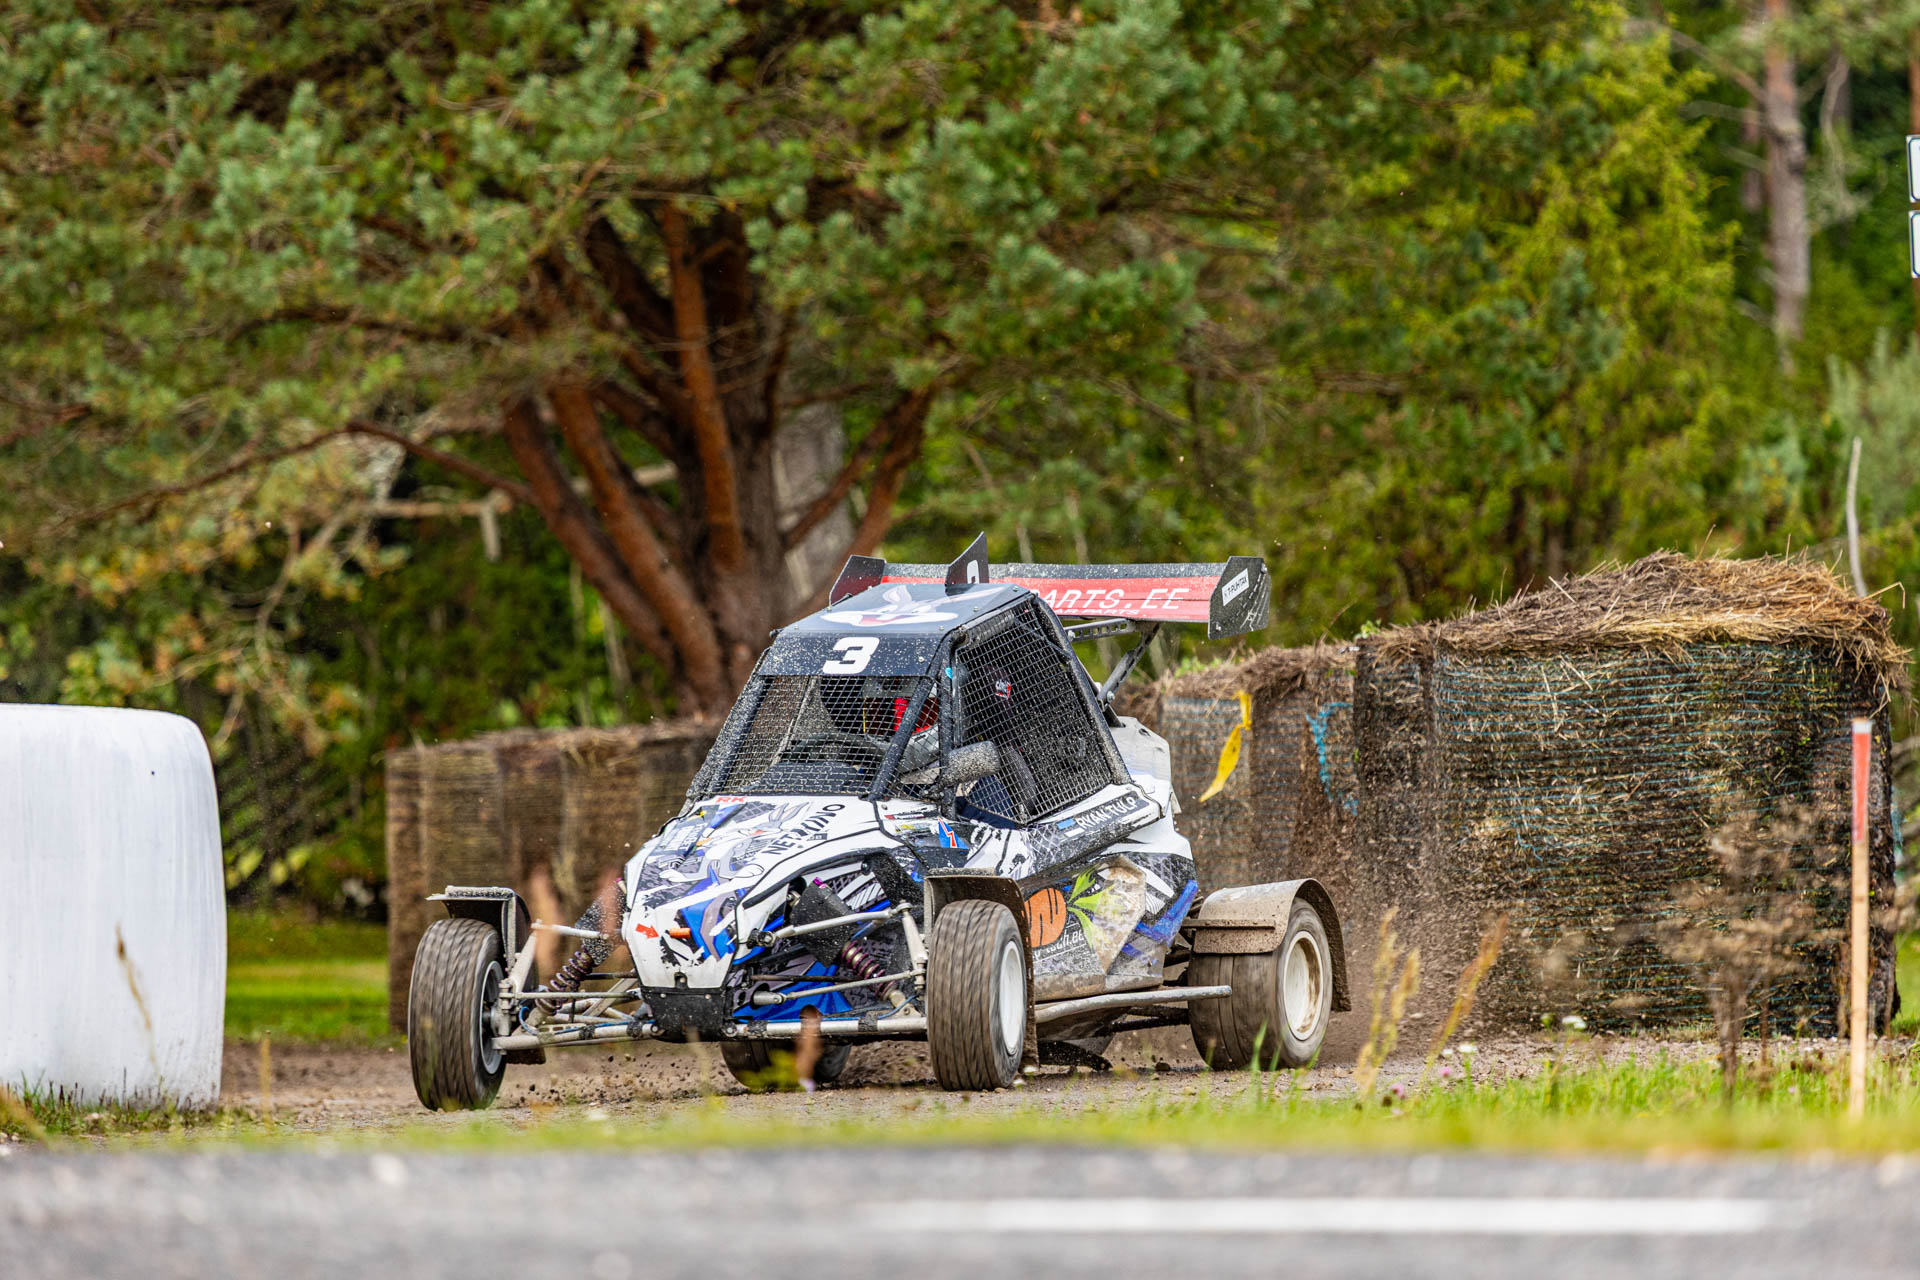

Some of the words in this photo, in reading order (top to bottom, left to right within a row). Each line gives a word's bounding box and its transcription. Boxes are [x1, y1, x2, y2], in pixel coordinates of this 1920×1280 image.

[1030, 588, 1189, 611] ARTS.EE
[822, 636, 880, 674] 3
[1075, 807, 1112, 830] RYAN
[1106, 795, 1139, 817] TULP
